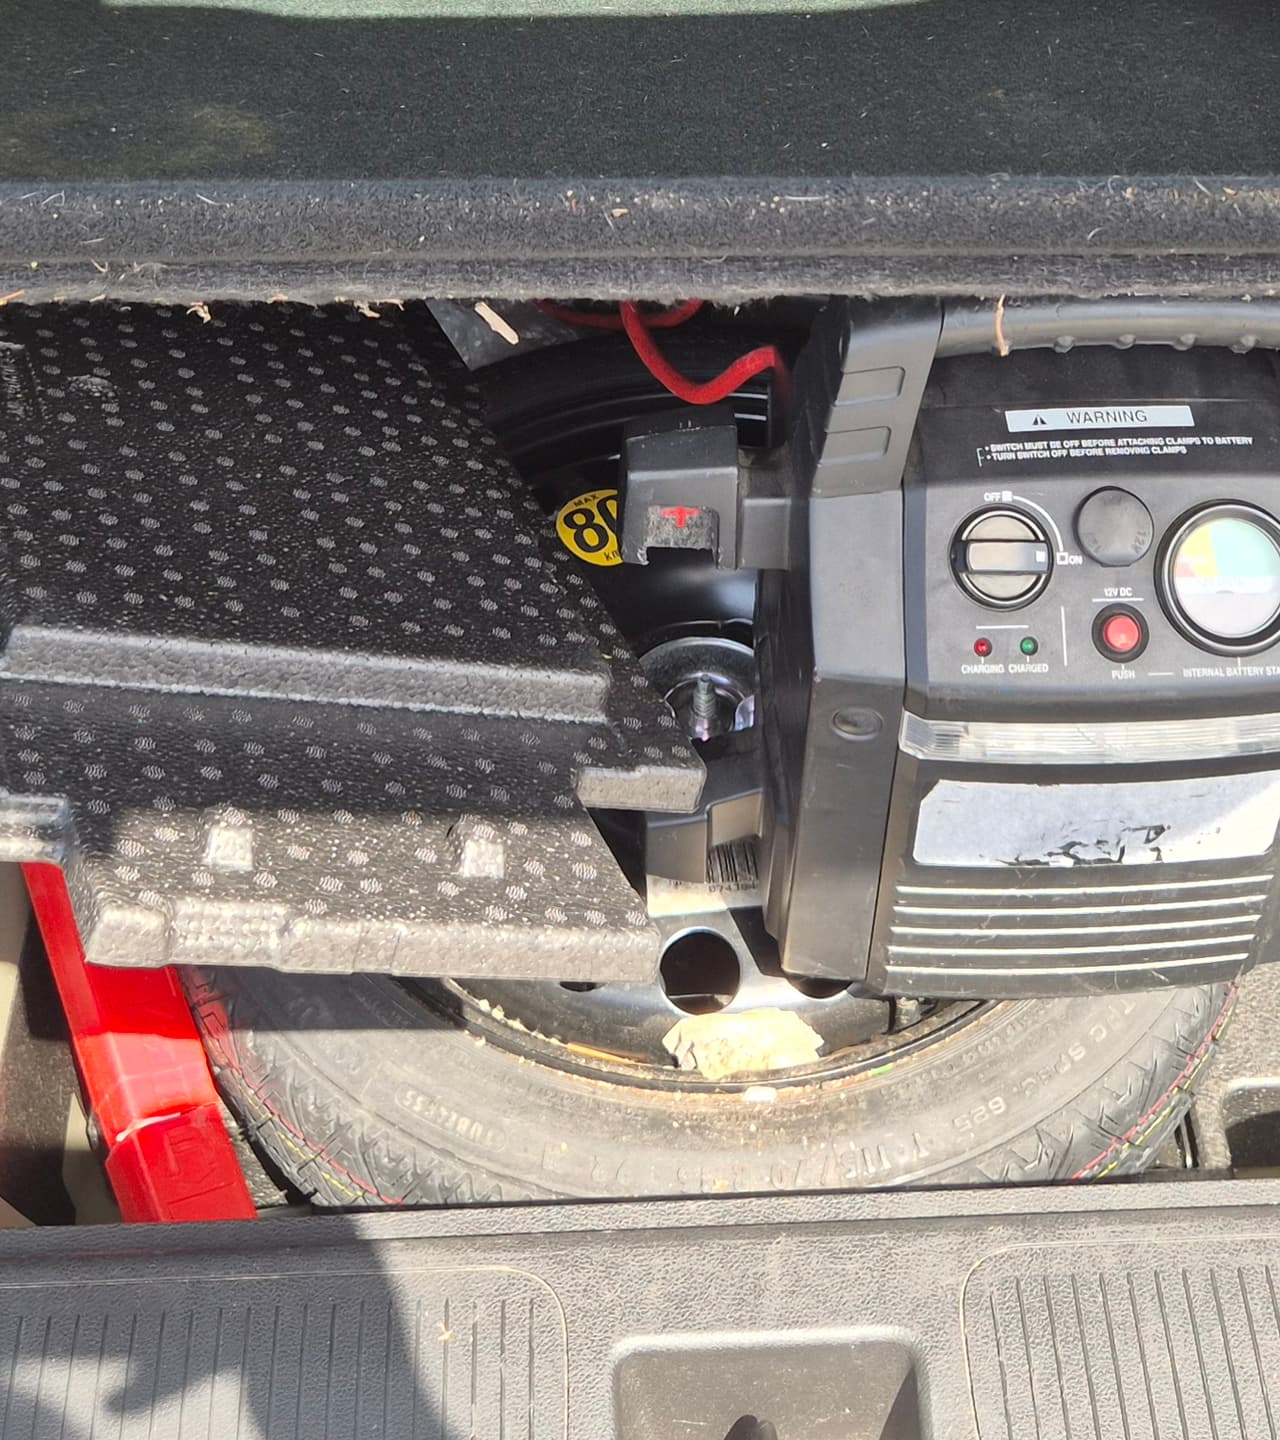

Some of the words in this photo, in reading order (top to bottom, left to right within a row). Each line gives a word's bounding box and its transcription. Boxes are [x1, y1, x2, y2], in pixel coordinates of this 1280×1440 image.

[1067, 410, 1147, 424] WARNING
[990, 442, 1023, 452] SWITCH
[1024, 442, 1048, 450] MUST
[1050, 441, 1061, 449] BE
[1063, 440, 1080, 448] OFF
[1082, 439, 1116, 448] BEFORE
[1117, 438, 1164, 446] ATTACHING
[1166, 437, 1200, 445] CLAMPS
[1215, 436, 1253, 444] BATTERY
[992, 452, 1016, 460] TURN
[1017, 450, 1049, 460] SWITCH
[1051, 449, 1068, 458] OFF
[1070, 448, 1104, 457] BEFORE
[1105, 447, 1150, 456] REMOVING
[1151, 446, 1187, 454] CLAMPS
[573, 494, 599, 507] MAX
[984, 492, 1001, 502] OFF
[1069, 556, 1082, 565] ON
[1104, 588, 1119, 597] 12V
[1120, 588, 1132, 596] DC
[961, 664, 1004, 674] CHARGING
[1008, 664, 1048, 673] CHARGED
[1183, 668, 1225, 678] INTERNAL
[1226, 667, 1264, 677] BATTERY
[1112, 670, 1135, 679] PUSH
